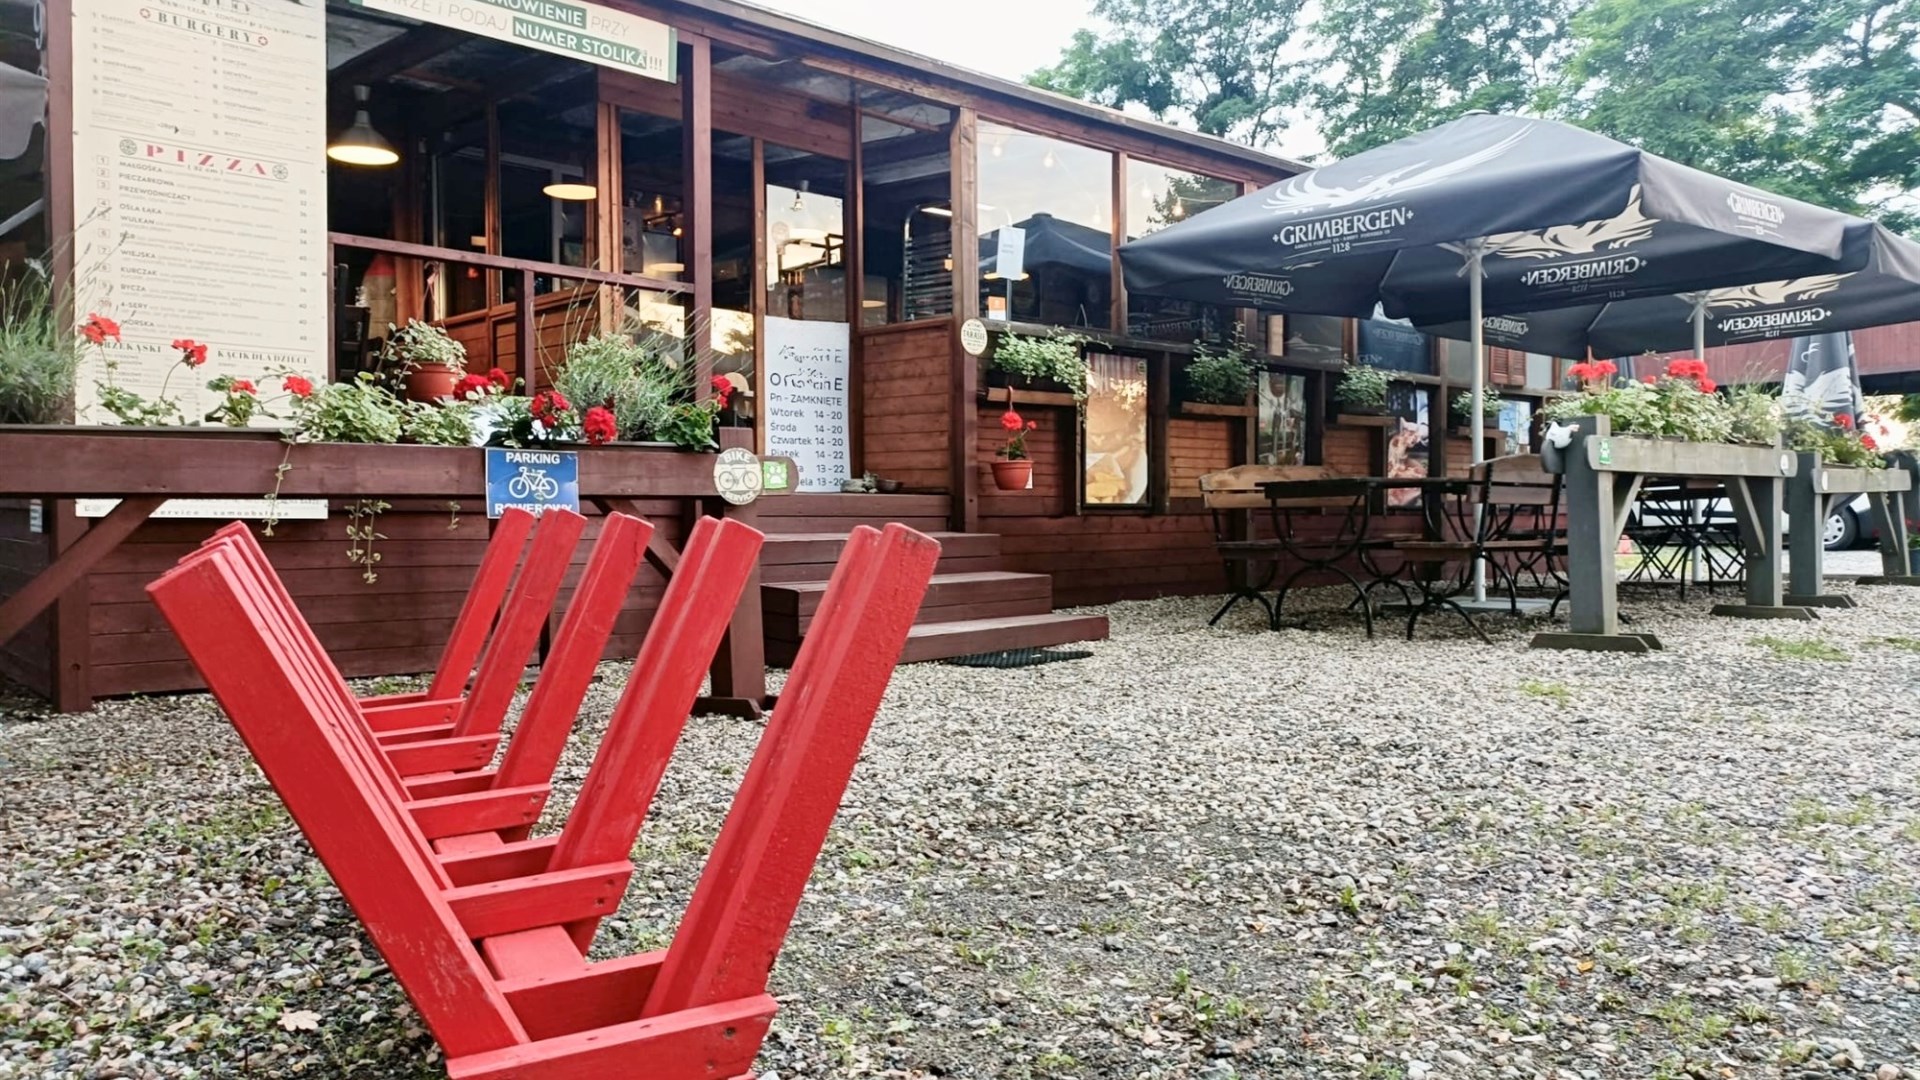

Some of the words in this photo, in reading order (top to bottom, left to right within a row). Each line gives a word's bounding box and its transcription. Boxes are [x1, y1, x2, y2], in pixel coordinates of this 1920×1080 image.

[158, 12, 250, 42] BURGERY
[591, 16, 629, 36] PRZY
[448, 4, 507, 31] PODAJ
[515, 21, 577, 49] NUMER
[582, 38, 646, 67] STOLIKA
[146, 144, 266, 175] PIZZA
[1730, 192, 1782, 224] GRIMBERGEN
[120, 215, 155, 225] WULKAN
[1280, 207, 1406, 246] GRIMBERGEN
[120, 249, 156, 259] WIEJSKA
[1332, 242, 1351, 254] 1128
[120, 266, 158, 276] KURCZAK
[98, 342, 161, 354] RZEKĄSKI
[770, 392, 782, 401] Pn
[790, 394, 842, 407] ZAMKNIĘTE
[770, 407, 805, 418] Wtorek
[770, 420, 797, 432] Środa
[770, 435, 812, 445] Czwartek
[505, 452, 560, 464] PARKING
[723, 450, 751, 463] BIKE
